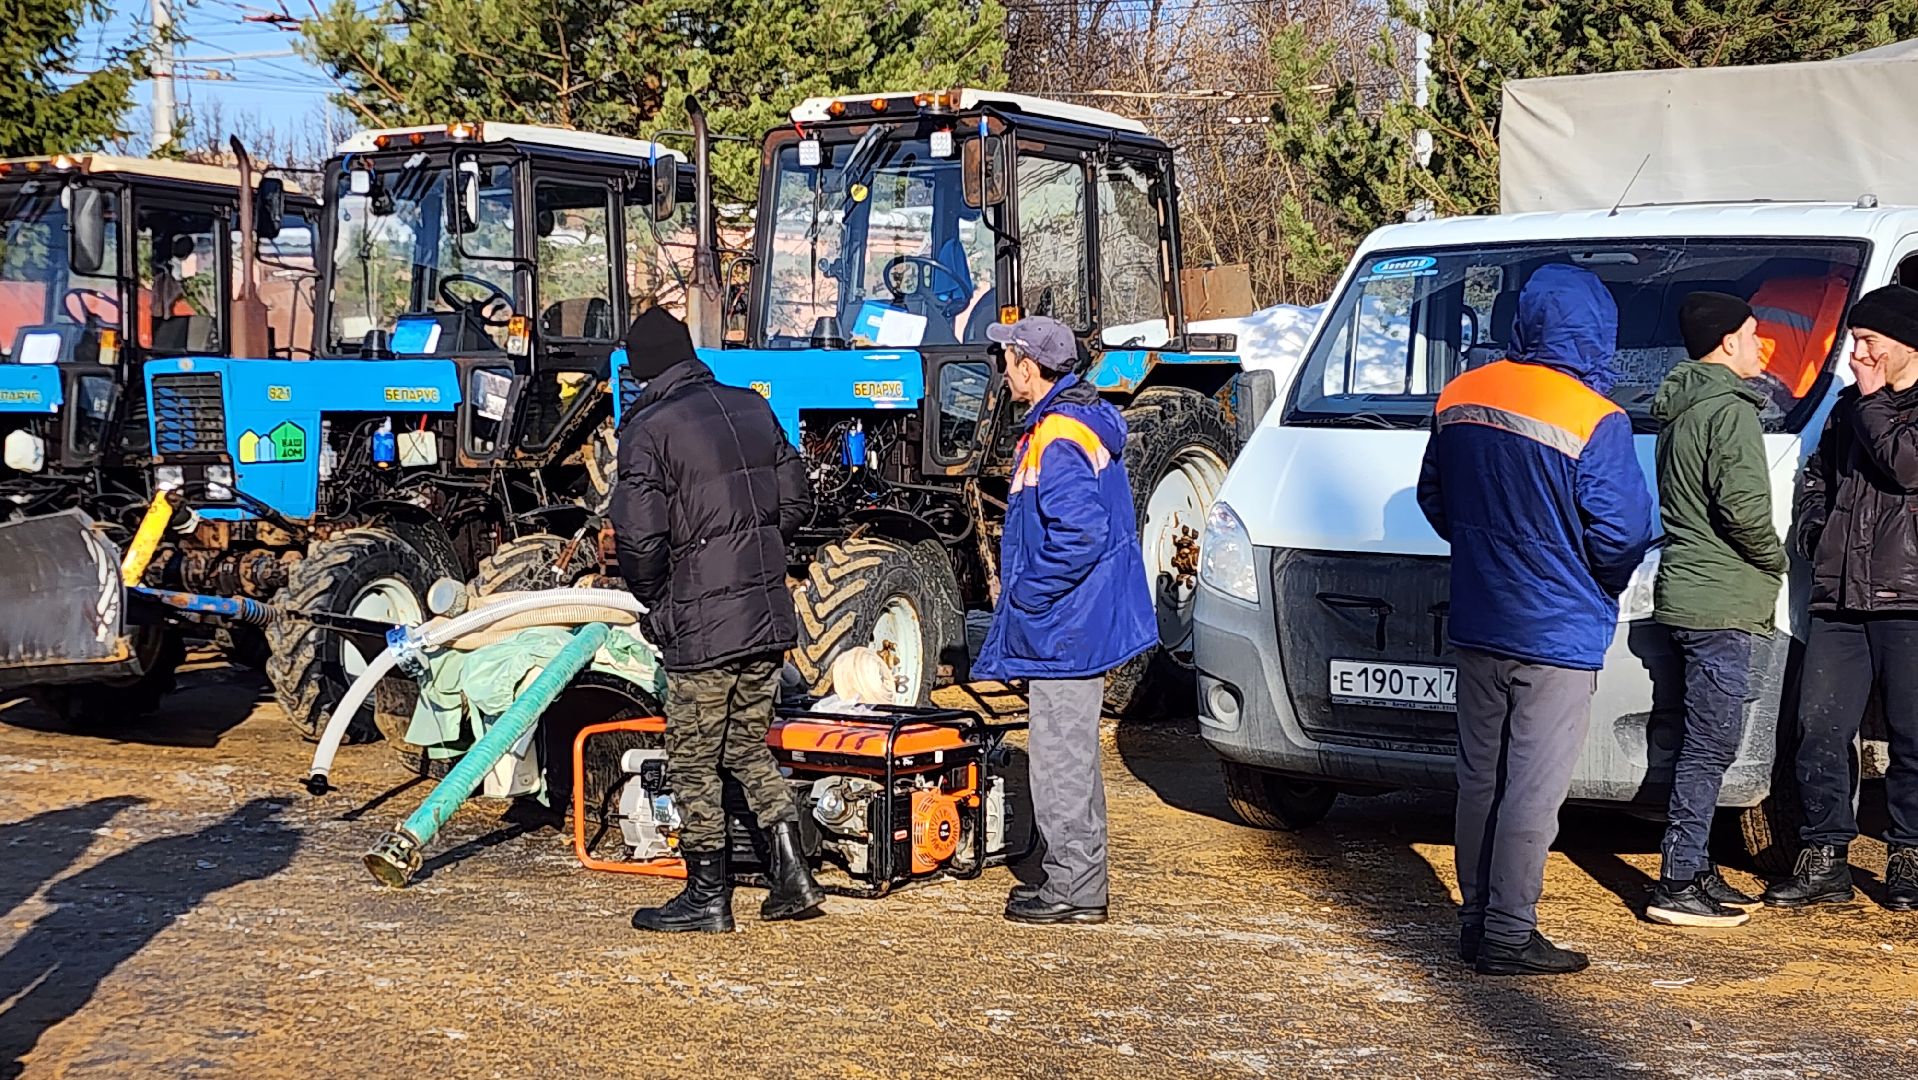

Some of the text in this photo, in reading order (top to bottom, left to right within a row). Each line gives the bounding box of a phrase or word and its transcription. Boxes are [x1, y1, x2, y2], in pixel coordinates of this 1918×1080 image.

[384, 388, 439, 401] БЕЛАРУС
[853, 382, 903, 397] БЕЛАРУС
[1443, 670, 1456, 692] 7
